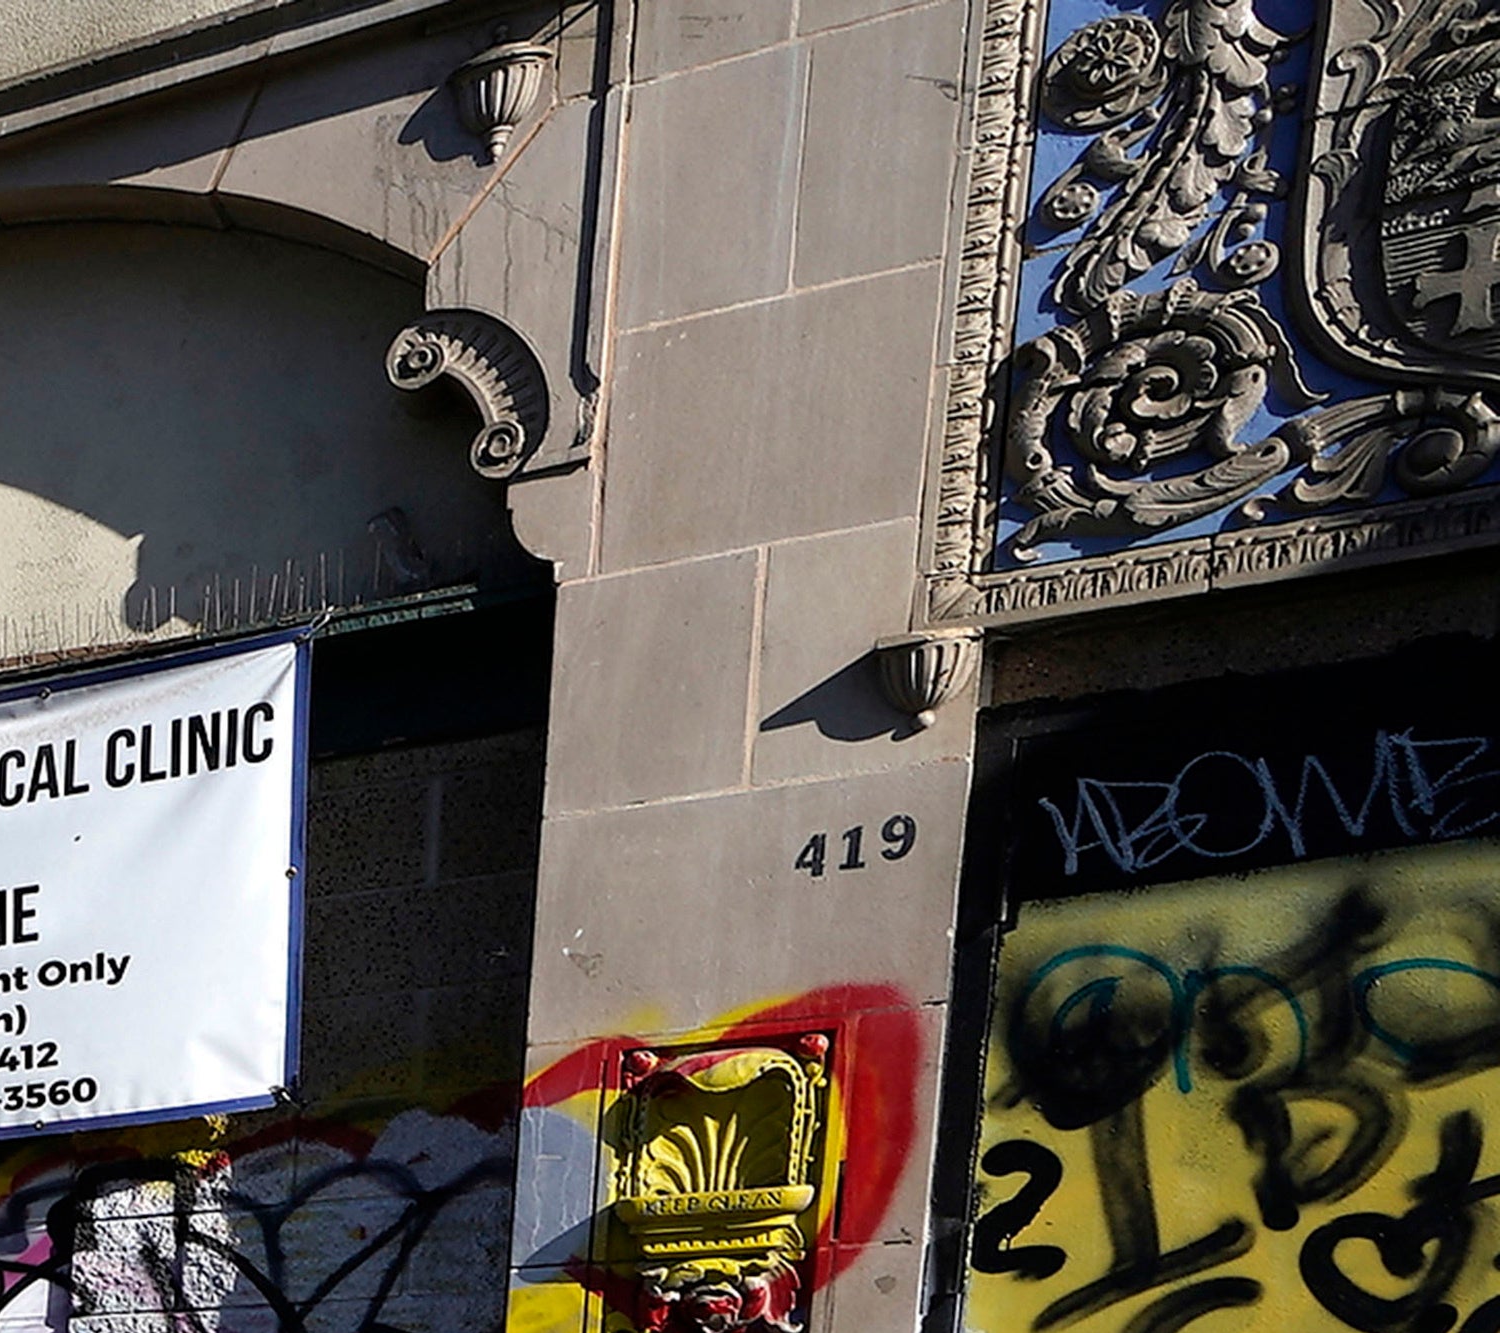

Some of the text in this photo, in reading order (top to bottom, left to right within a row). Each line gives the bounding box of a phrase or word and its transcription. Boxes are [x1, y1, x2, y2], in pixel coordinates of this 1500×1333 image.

[104, 701, 274, 790] CLINIC
[795, 812, 918, 879] 419
[37, 952, 131, 987] Only
